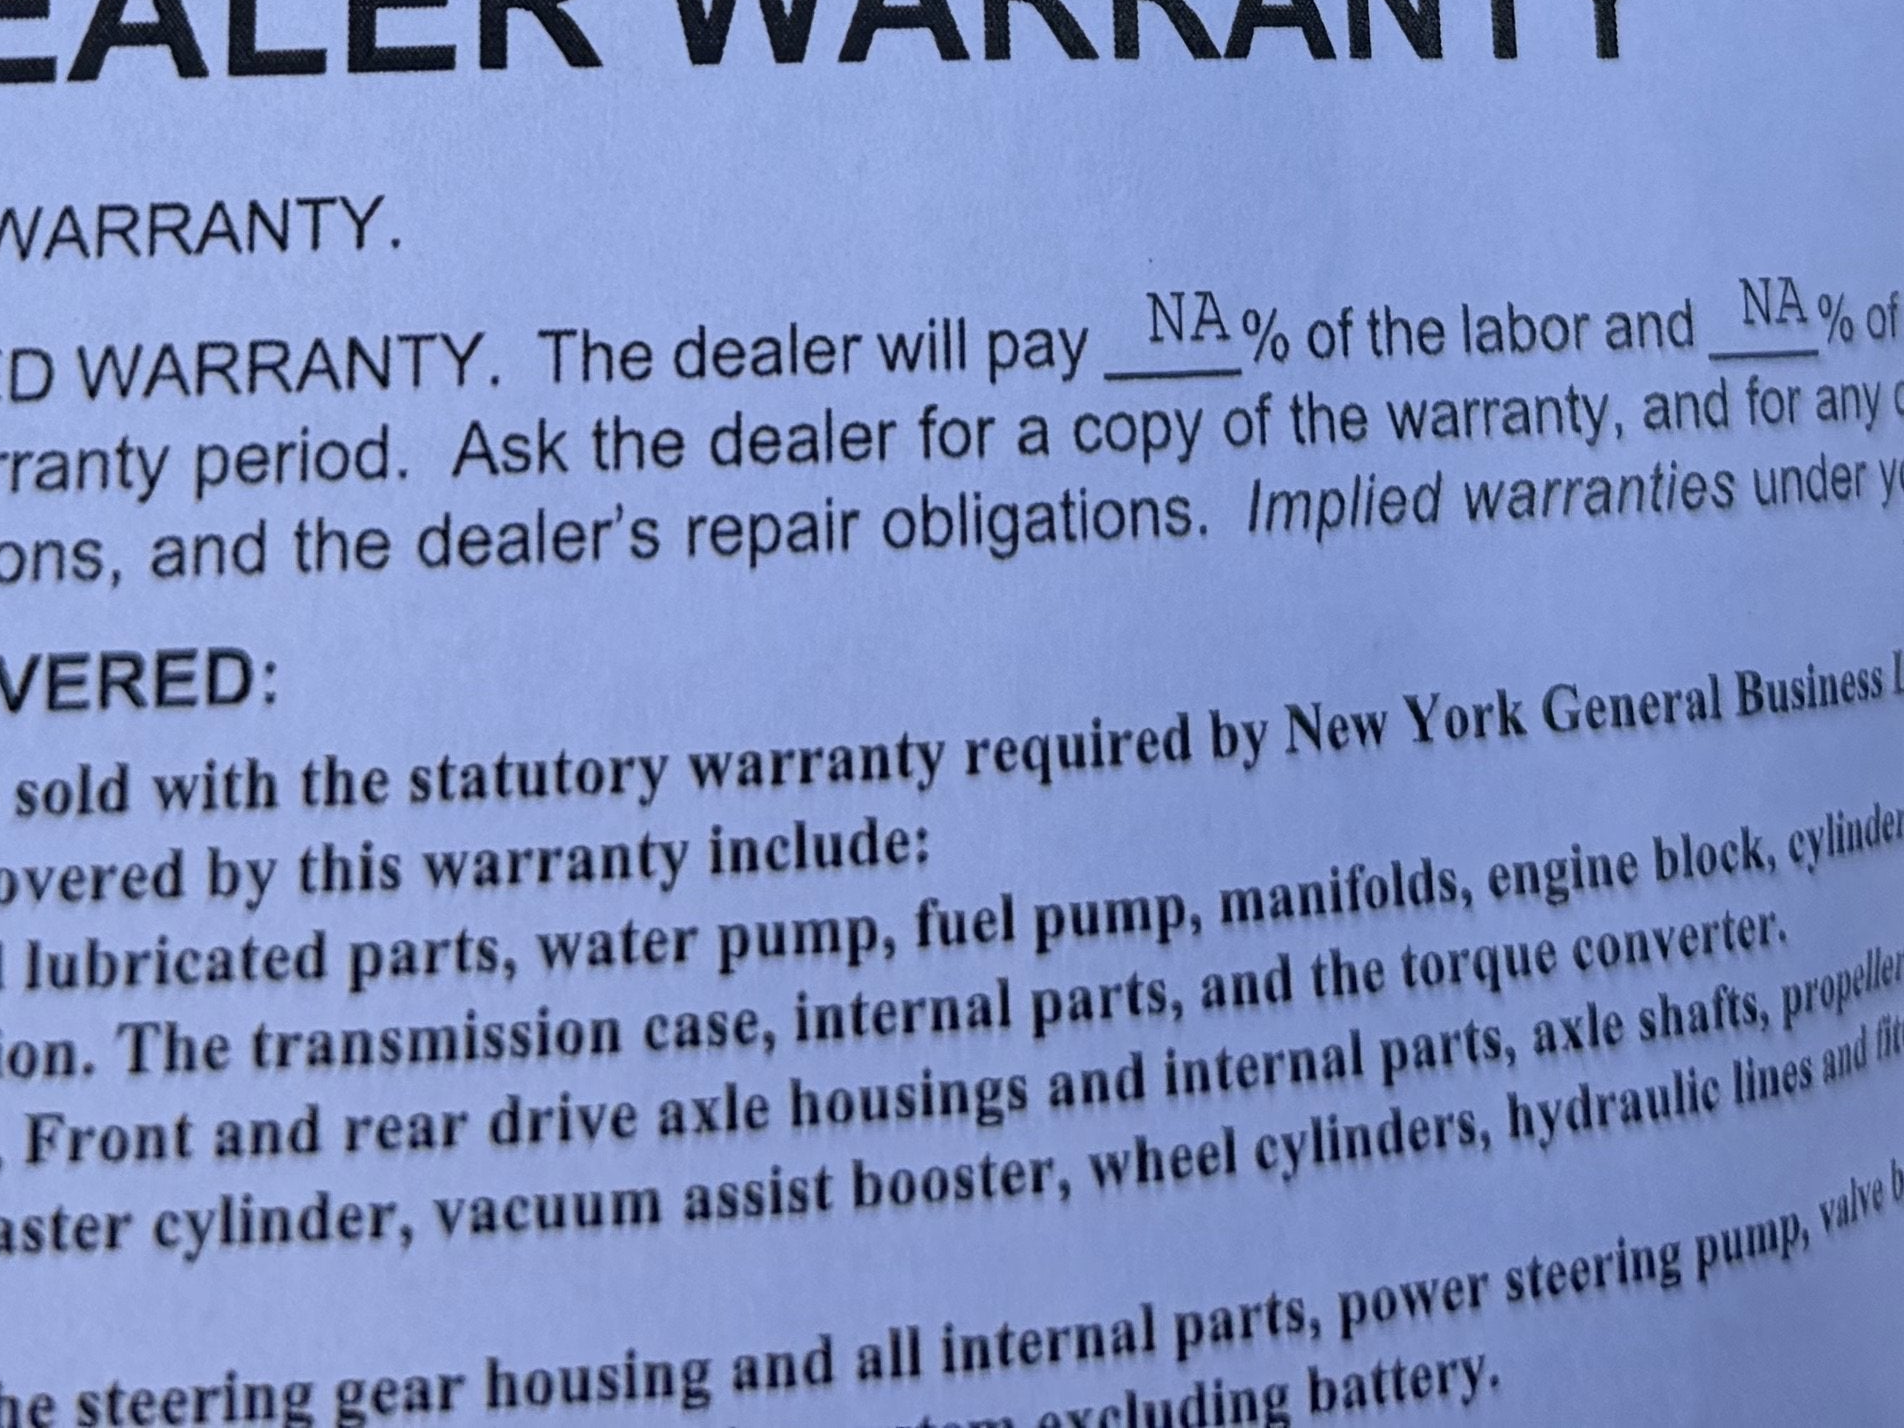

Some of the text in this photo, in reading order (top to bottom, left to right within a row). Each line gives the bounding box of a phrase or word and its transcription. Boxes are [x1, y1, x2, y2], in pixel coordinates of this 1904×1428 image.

[76, 332, 499, 401] WARRANTY.
[537, 328, 653, 384] The
[673, 322, 863, 380] dealer
[876, 316, 966, 373] will
[988, 327, 1089, 386] pay
[1307, 306, 1353, 361] of
[1367, 305, 1445, 359] the
[1462, 301, 1590, 356] labor
[1606, 298, 1694, 351] and
[1867, 291, 1899, 343] of
[15, 762, 130, 820] sold
[152, 757, 279, 814] with
[301, 754, 390, 809] the
[409, 749, 669, 809] statutory
[688, 731, 945, 795] warranty
[965, 712, 1192, 788] required
[1209, 709, 1268, 773] by
[1284, 702, 1388, 755] New
[1403, 689, 1528, 745] York
[1542, 673, 1723, 734] General
[1735, 663, 1886, 719] Business
[25, 929, 328, 993] lubricated
[349, 928, 517, 996] parts,
[536, 919, 699, 973] water
[718, 916, 896, 979] pump,
[915, 893, 1015, 951] fuel
[1034, 894, 1202, 959] pump,
[1220, 857, 1473, 928] manifolds,
[1488, 843, 1638, 909] engine
[1653, 826, 1776, 884] block,
[153, 1190, 413, 1264] cylinder,
[433, 1188, 662, 1238] vacuum
[684, 1164, 833, 1225] assist
[852, 1153, 1073, 1212] booster,
[1089, 1126, 1237, 1192] wheel
[1255, 1106, 1491, 1187] cylinders,
[1507, 1067, 1719, 1153] hydraulic
[1733, 1056, 1813, 1108] lines
[1306, 1352, 1498, 1414] battery.
